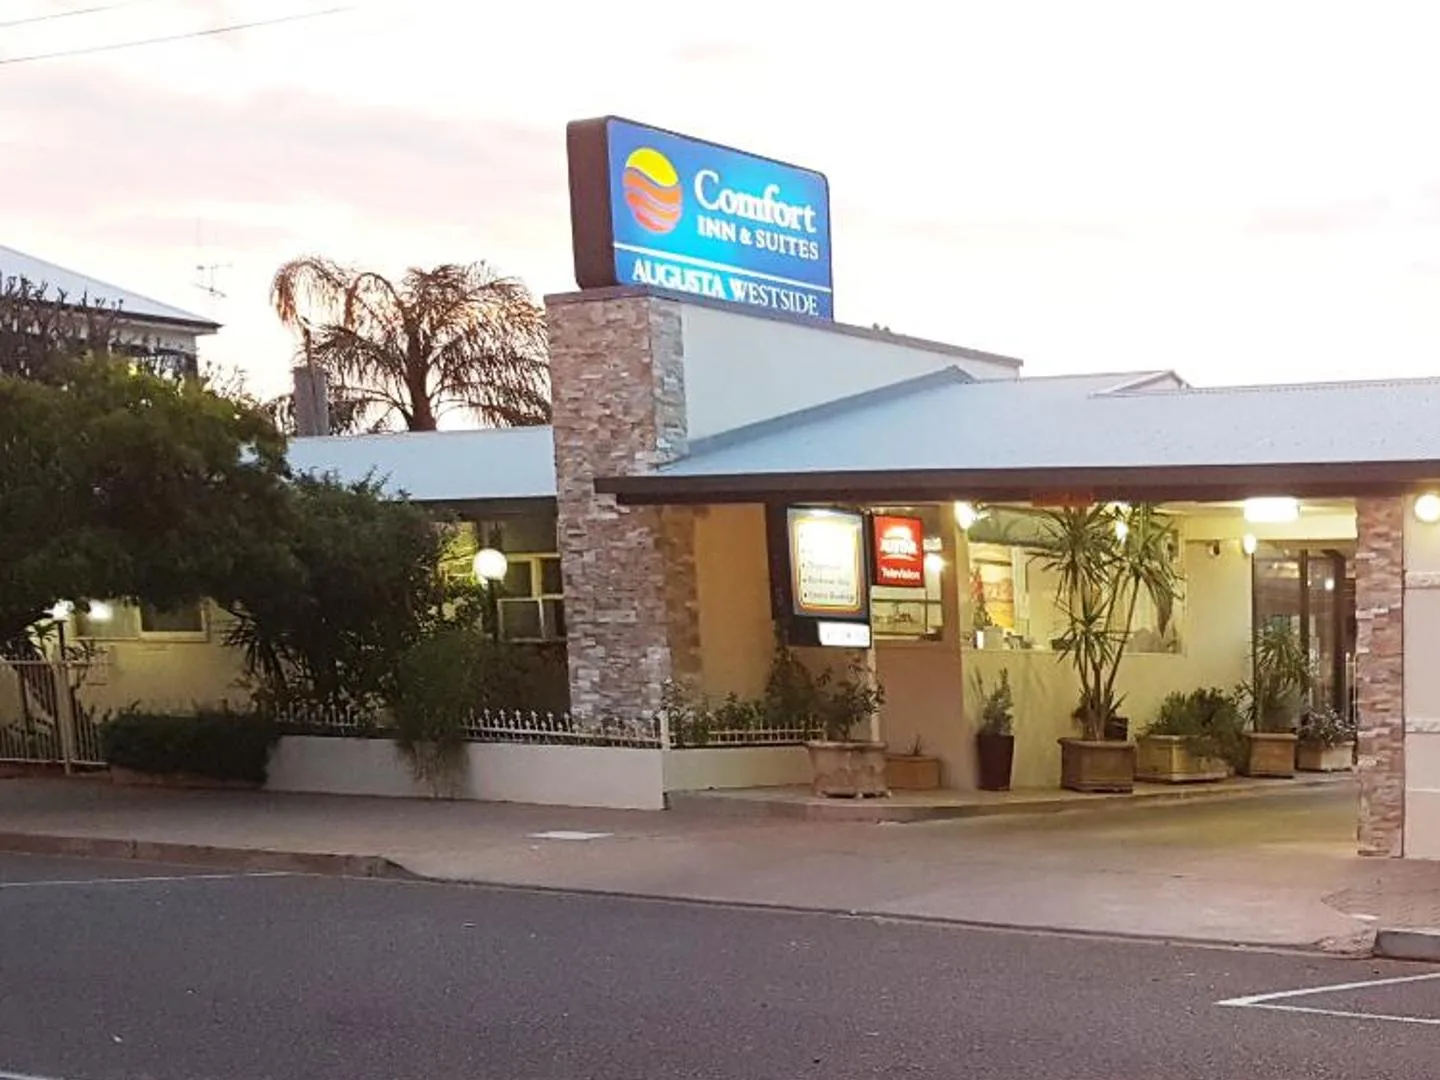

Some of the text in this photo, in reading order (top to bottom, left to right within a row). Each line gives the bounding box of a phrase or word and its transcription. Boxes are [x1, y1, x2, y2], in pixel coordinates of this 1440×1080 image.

[693, 169, 817, 234] Comfort
[696, 215, 819, 260] INN & SUITES
[632, 258, 819, 316] AUGUSTA WESTSIDE
